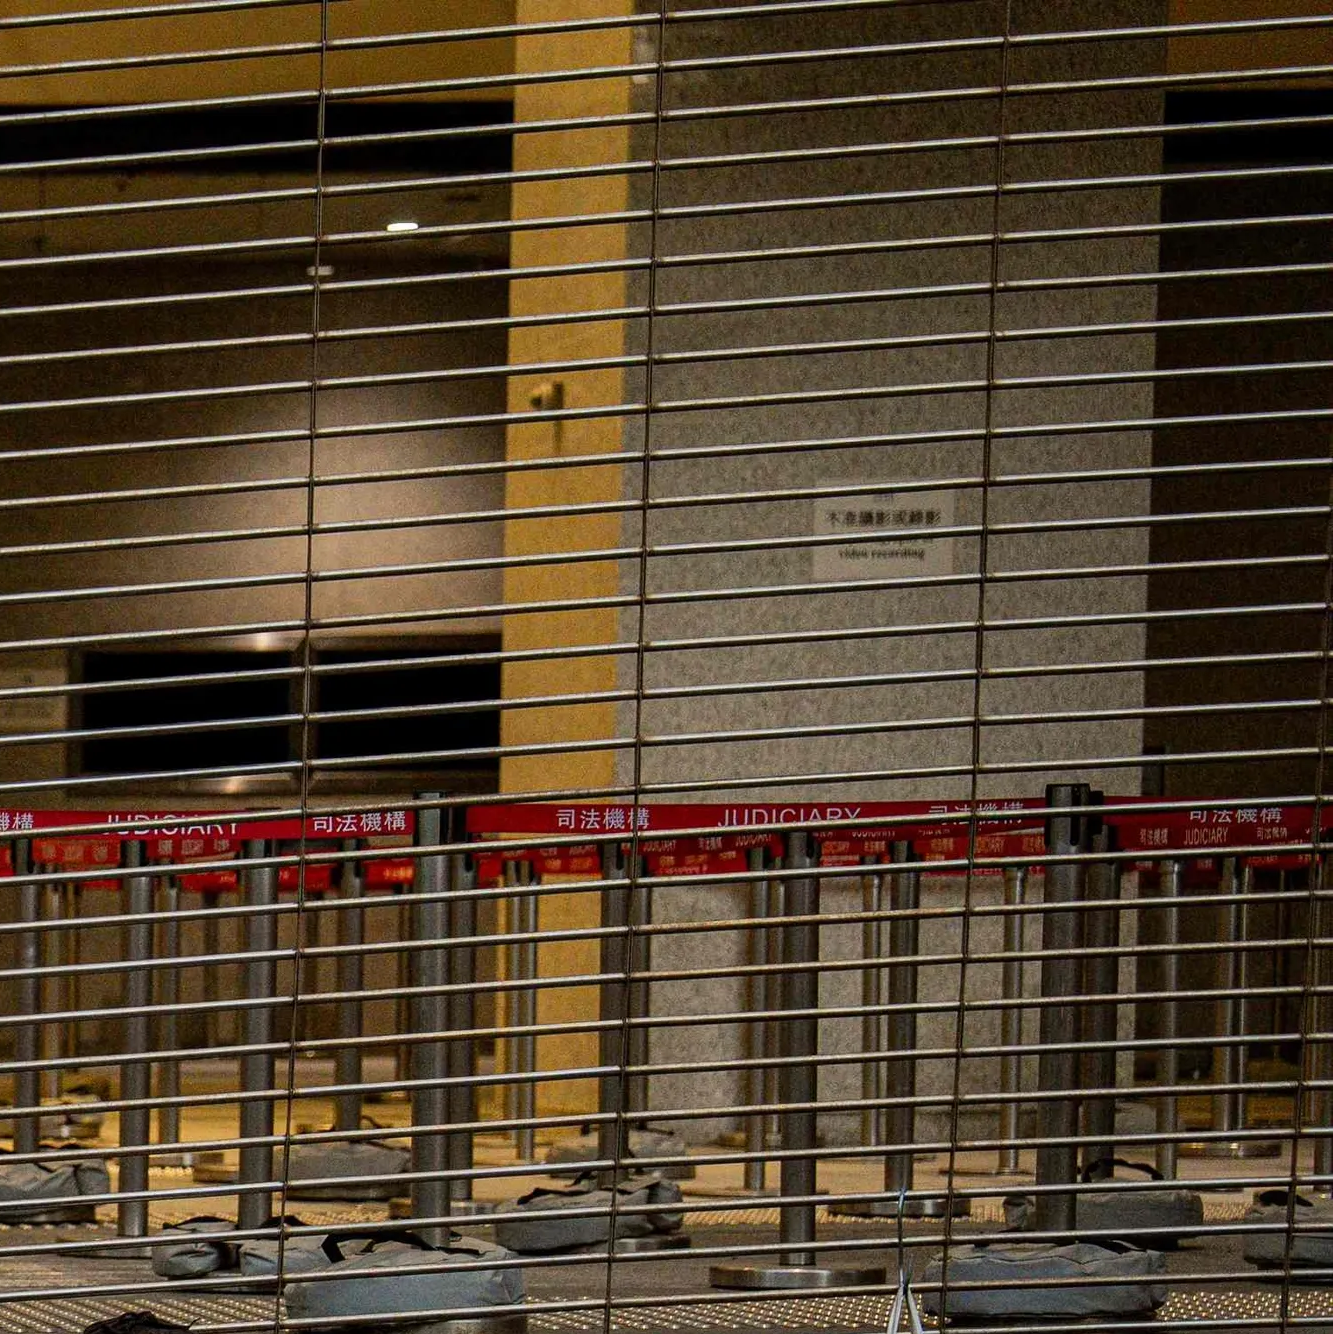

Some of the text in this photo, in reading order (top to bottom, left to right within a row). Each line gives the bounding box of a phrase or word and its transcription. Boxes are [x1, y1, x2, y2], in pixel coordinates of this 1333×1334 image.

[312, 810, 406, 833] 司法機構
[555, 808, 650, 830] 司法機構
[717, 807, 861, 828] JUDICIARY
[1183, 827, 1229, 846] JUDICIARY
